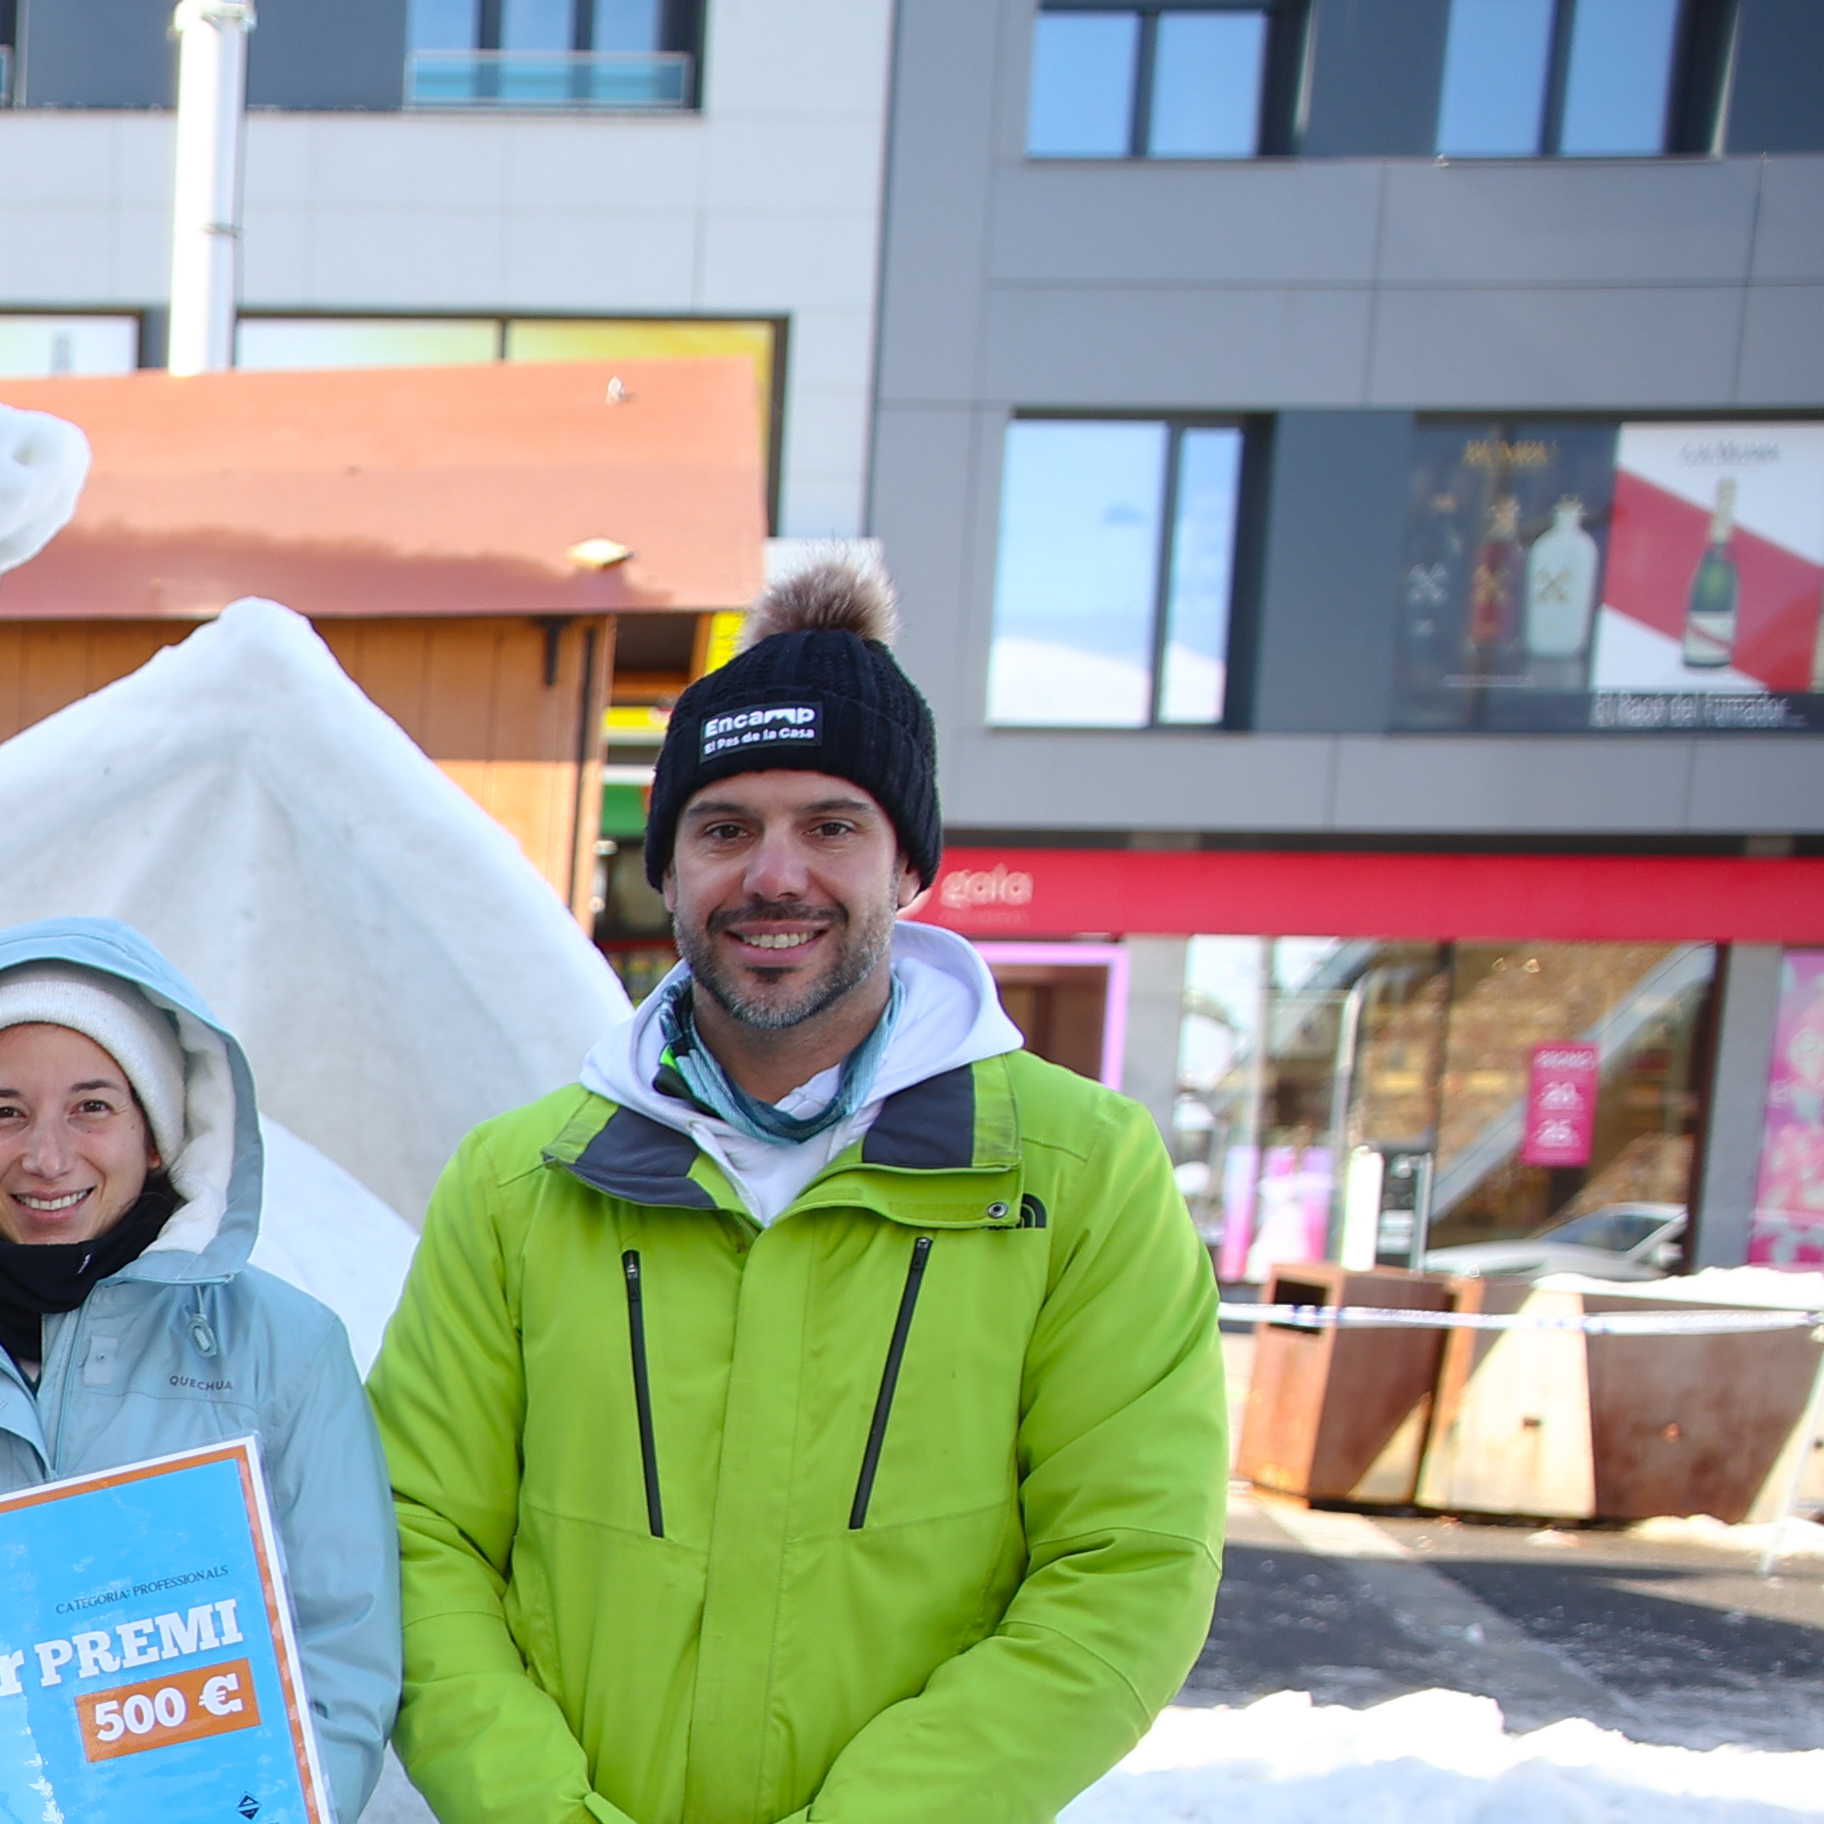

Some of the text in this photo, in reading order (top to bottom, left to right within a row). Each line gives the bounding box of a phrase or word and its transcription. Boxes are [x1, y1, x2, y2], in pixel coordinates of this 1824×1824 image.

[704, 707, 816, 739] Encamp
[717, 736, 740, 750] Pas
[741, 731, 761, 744] de
[763, 729, 777, 741] la
[779, 727, 815, 739] Casa
[169, 1375, 233, 1391] QUECHUA
[55, 1565, 229, 1615] CATEGORIA: PROFESSIONALS
[34, 1598, 244, 1688] PREMI
[94, 1672, 243, 1742] 500 €
